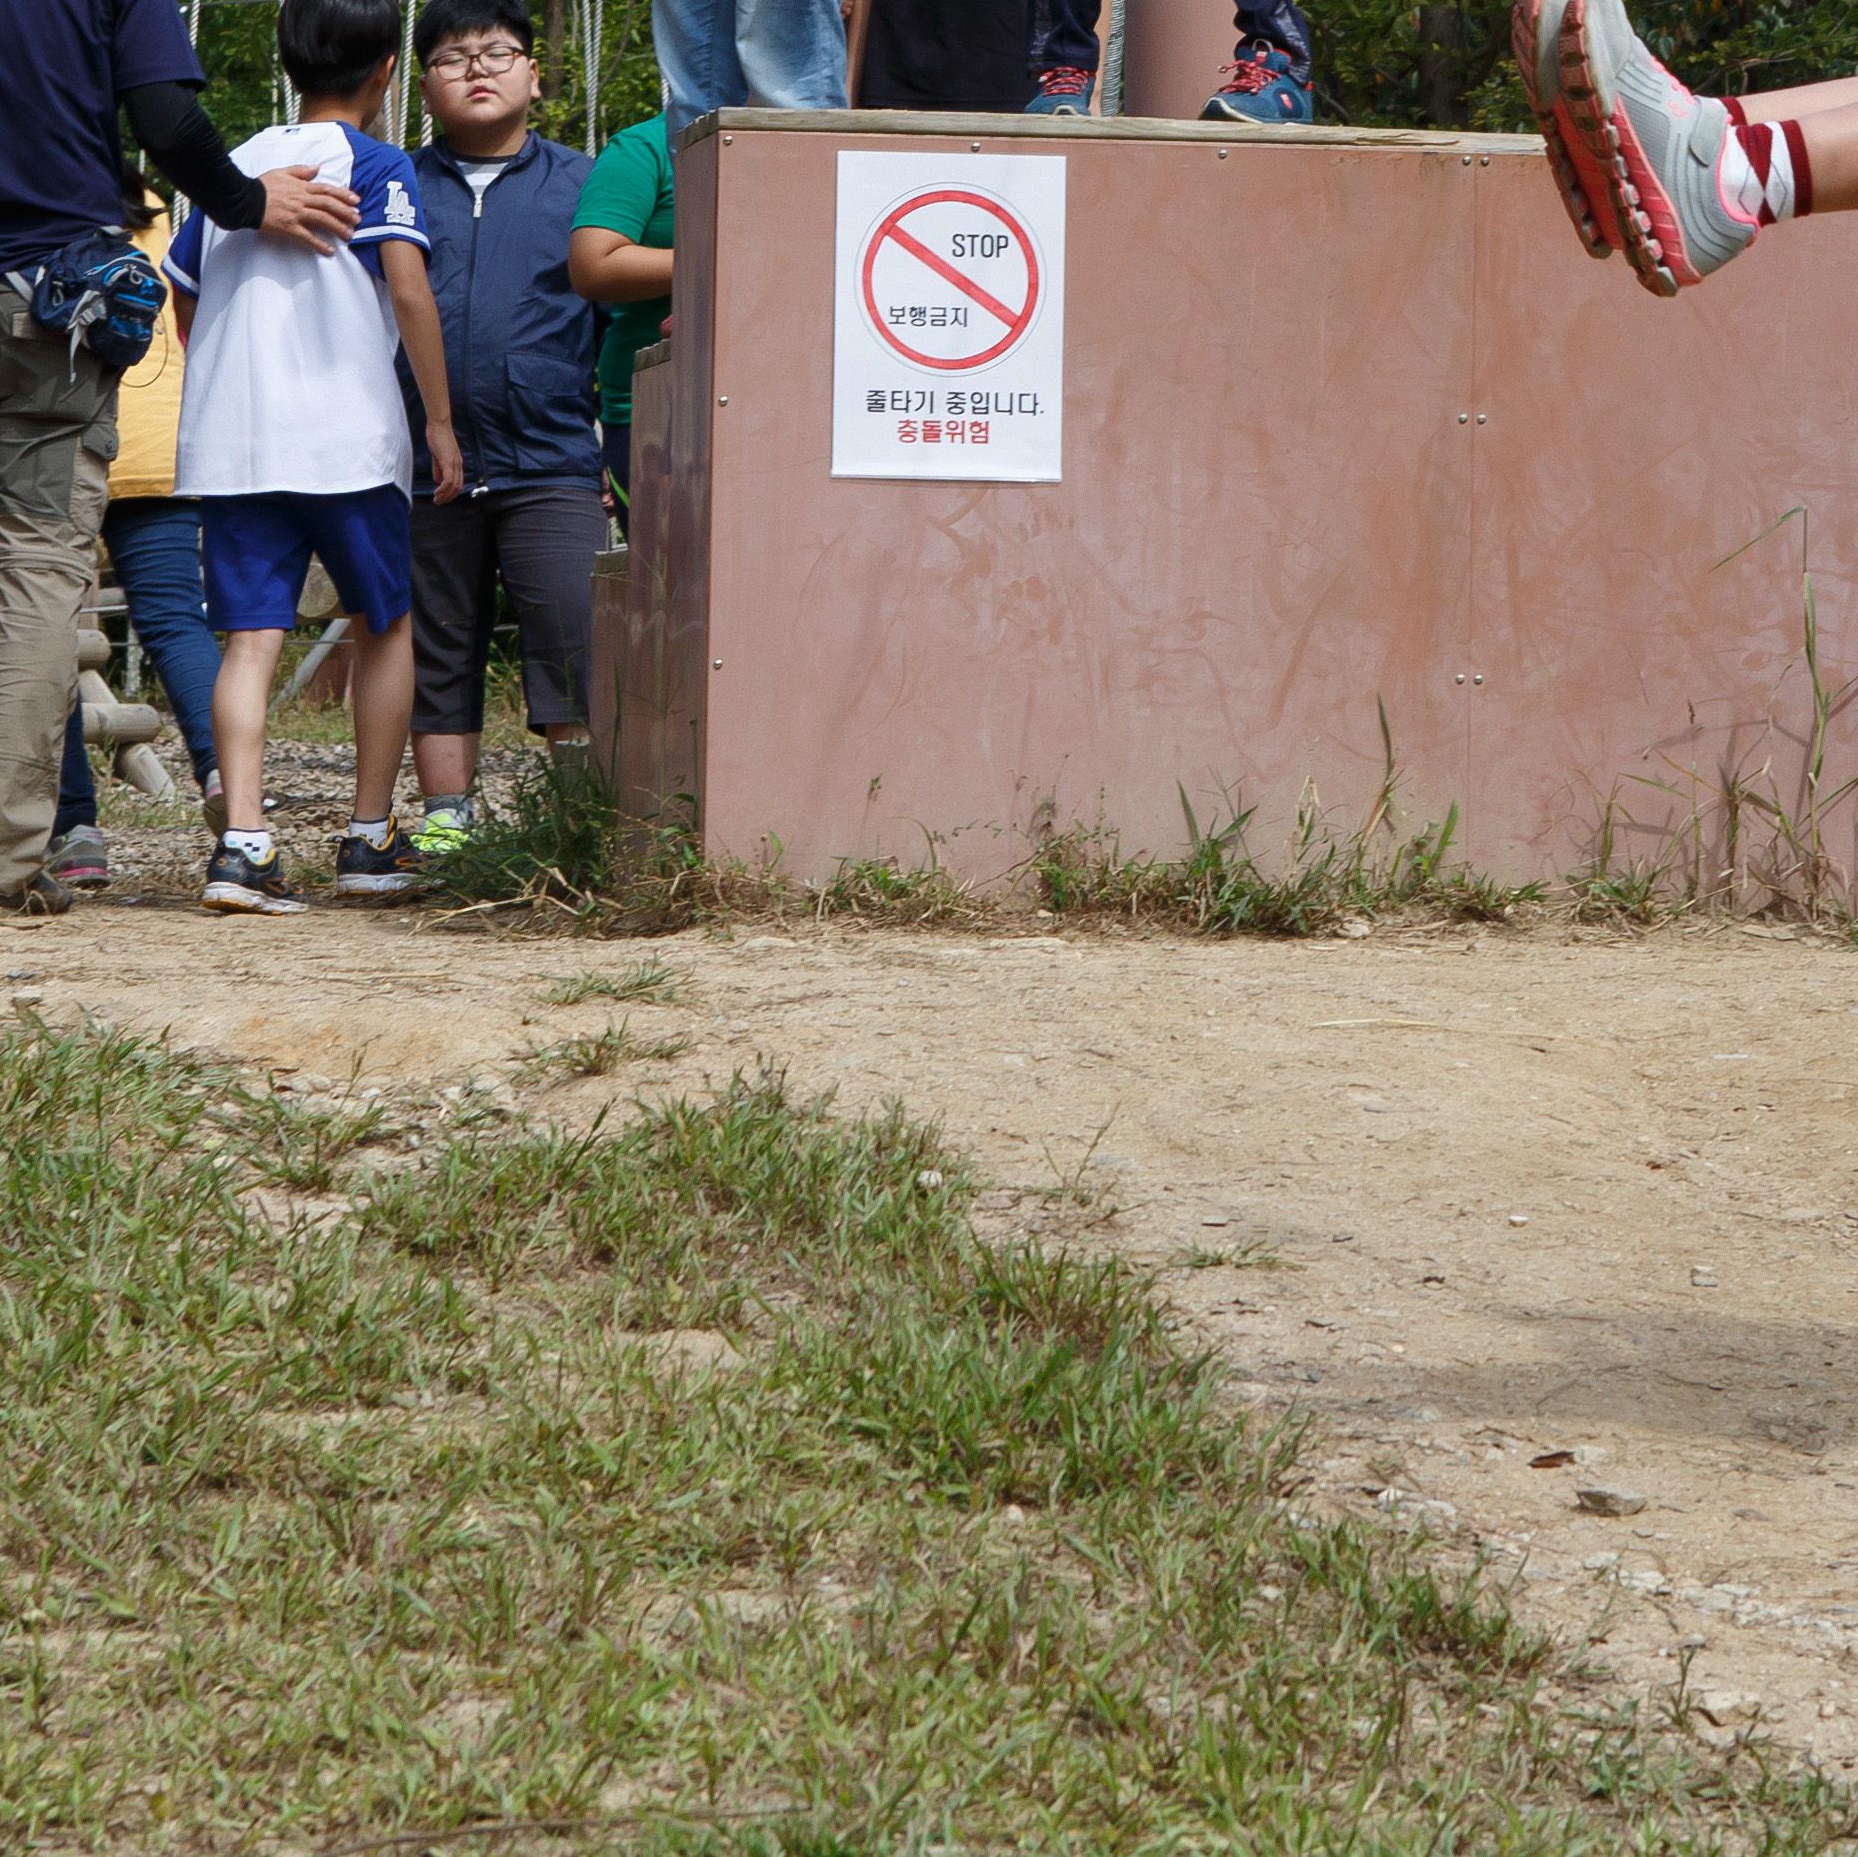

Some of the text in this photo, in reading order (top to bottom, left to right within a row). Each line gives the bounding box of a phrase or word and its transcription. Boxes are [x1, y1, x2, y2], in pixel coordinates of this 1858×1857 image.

[384, 180, 416, 226] LA
[951, 233, 1010, 258] STOP
[888, 305, 969, 328] 보행금지
[865, 389, 1045, 417] 줄타기 중입니다.
[896, 418, 991, 445] 충돌위험
